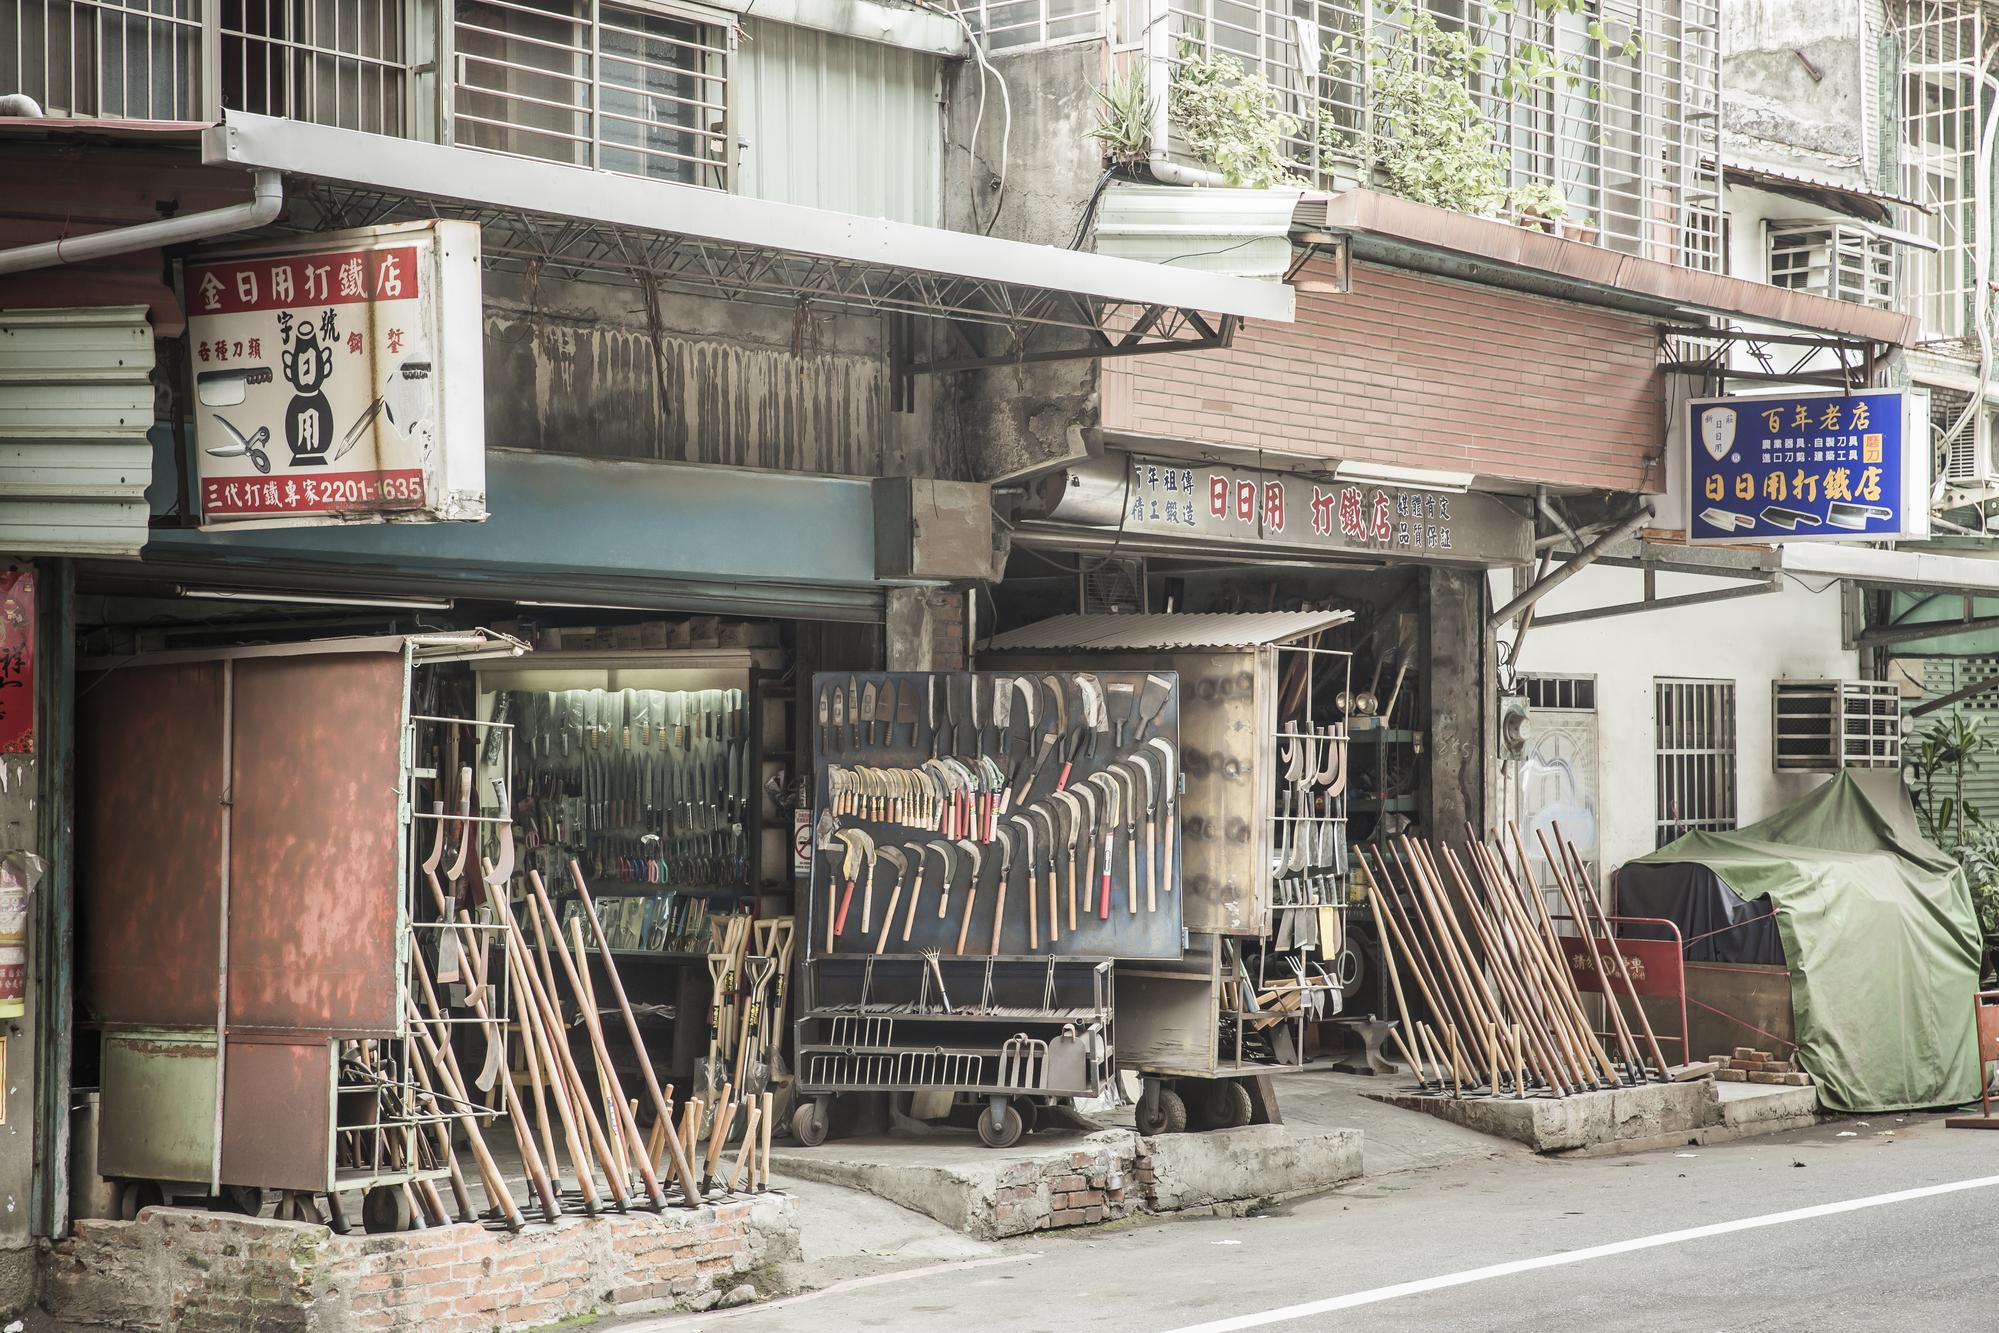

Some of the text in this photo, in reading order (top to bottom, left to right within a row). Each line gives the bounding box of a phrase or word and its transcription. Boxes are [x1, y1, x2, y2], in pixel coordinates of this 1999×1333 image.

[199, 254, 402, 310] 金日用打鐵店
[277, 308, 340, 345] 字號
[198, 338, 262, 362] 各種刀類
[297, 348, 320, 451] 日用
[1761, 402, 1870, 433] 百年老店
[1705, 466, 1883, 502] 日日用打鐵店
[1209, 475, 1392, 542] 日日用 打鐵店
